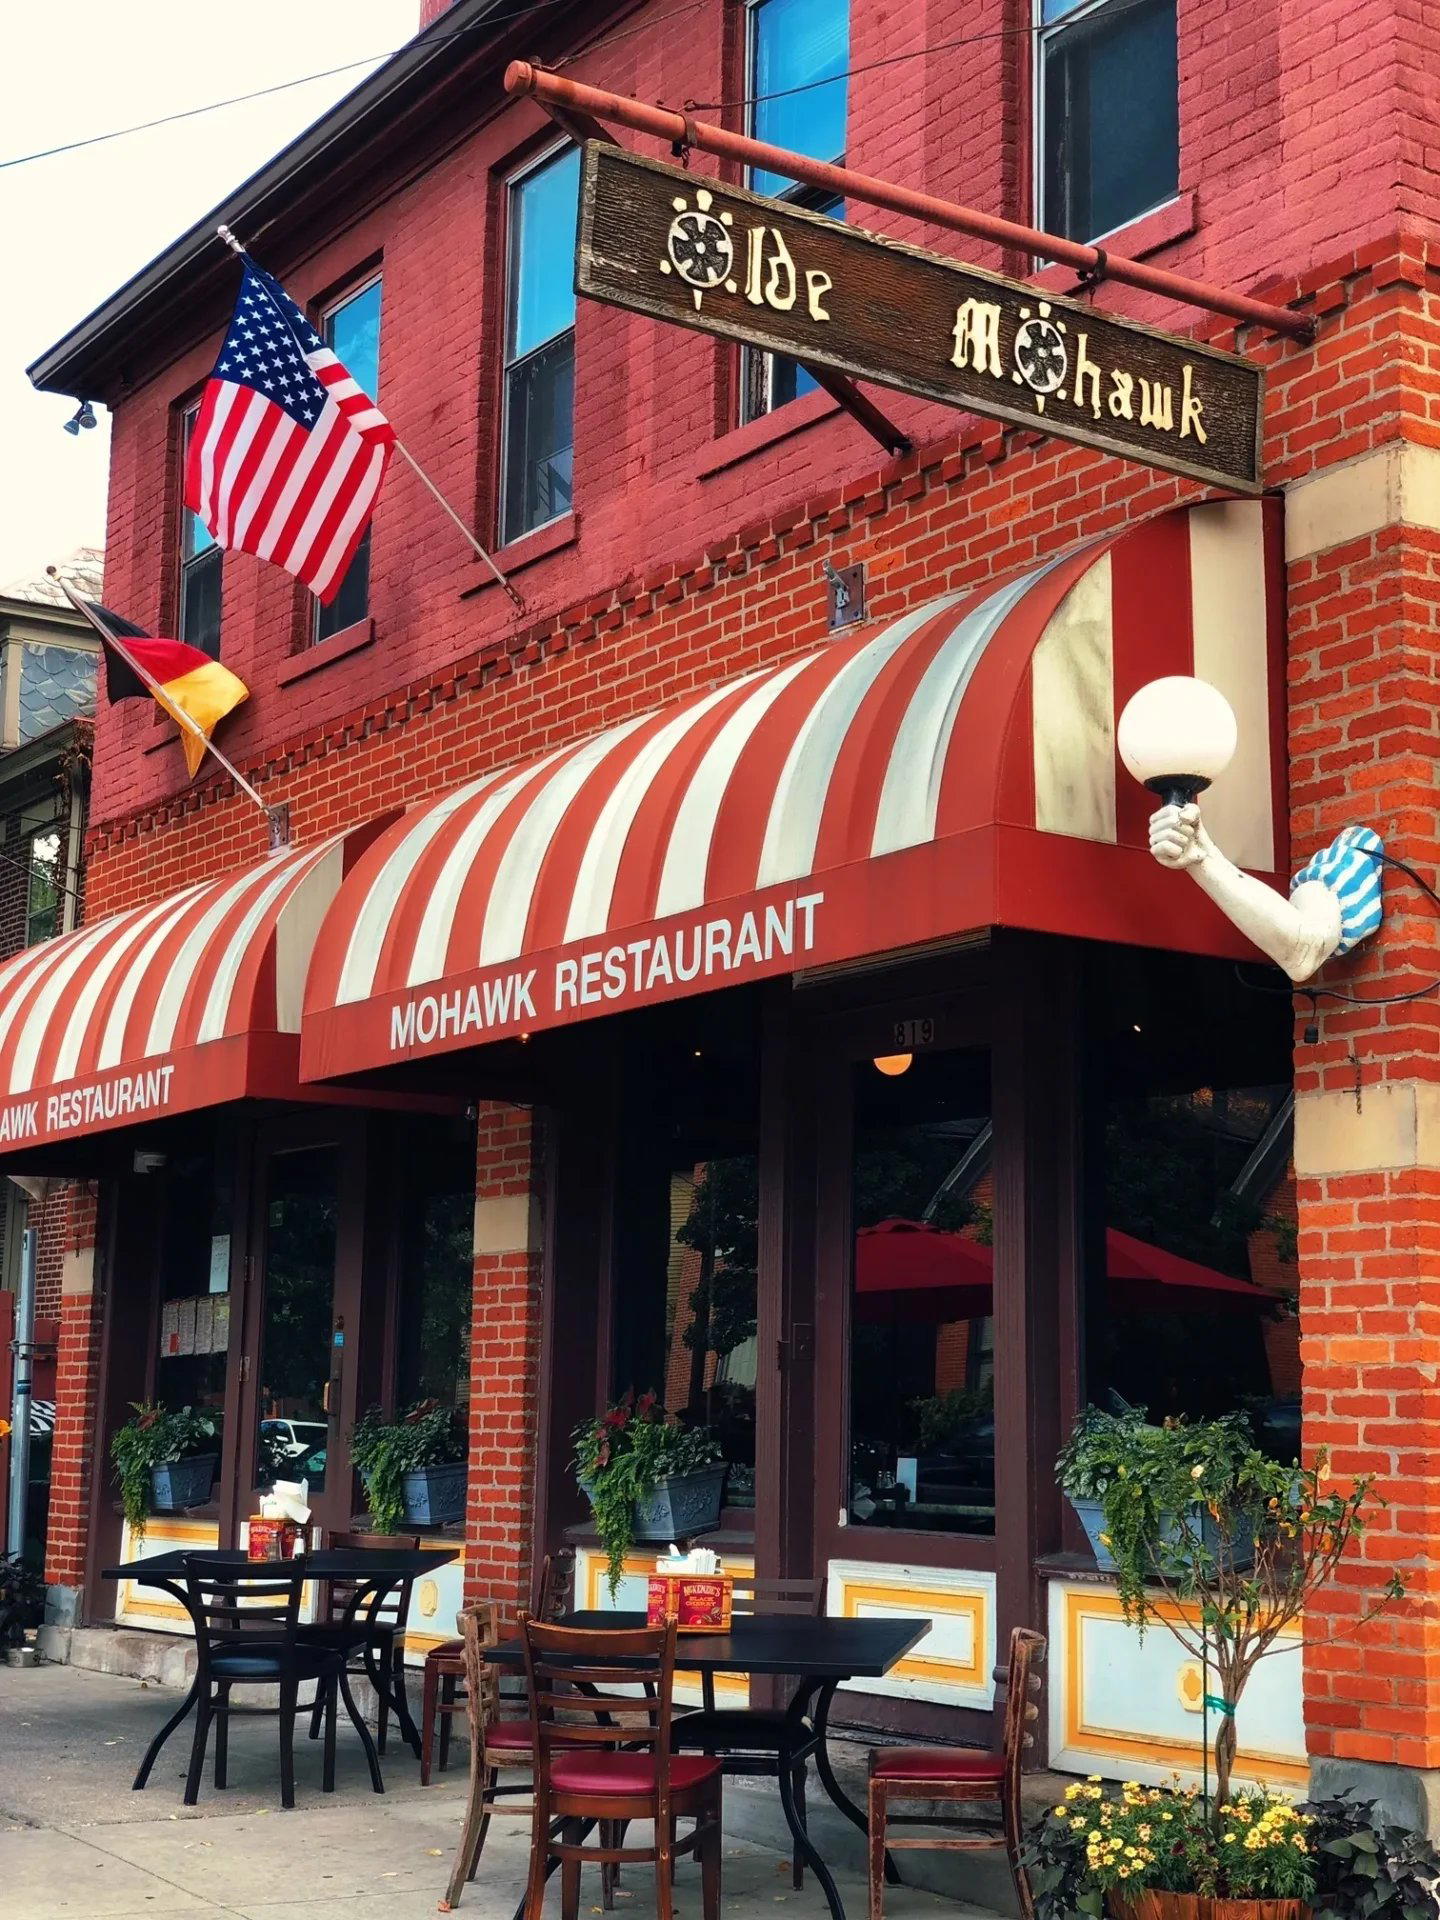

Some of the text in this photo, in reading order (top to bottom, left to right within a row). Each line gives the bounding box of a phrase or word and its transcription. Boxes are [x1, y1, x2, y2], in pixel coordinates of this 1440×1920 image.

[950, 296, 1207, 444] Mohawk
[390, 892, 825, 1050] MOHAWK RESTAURANT
[895, 1019, 934, 1046] 819
[0, 1064, 175, 1143] AWK RESTAURANT
